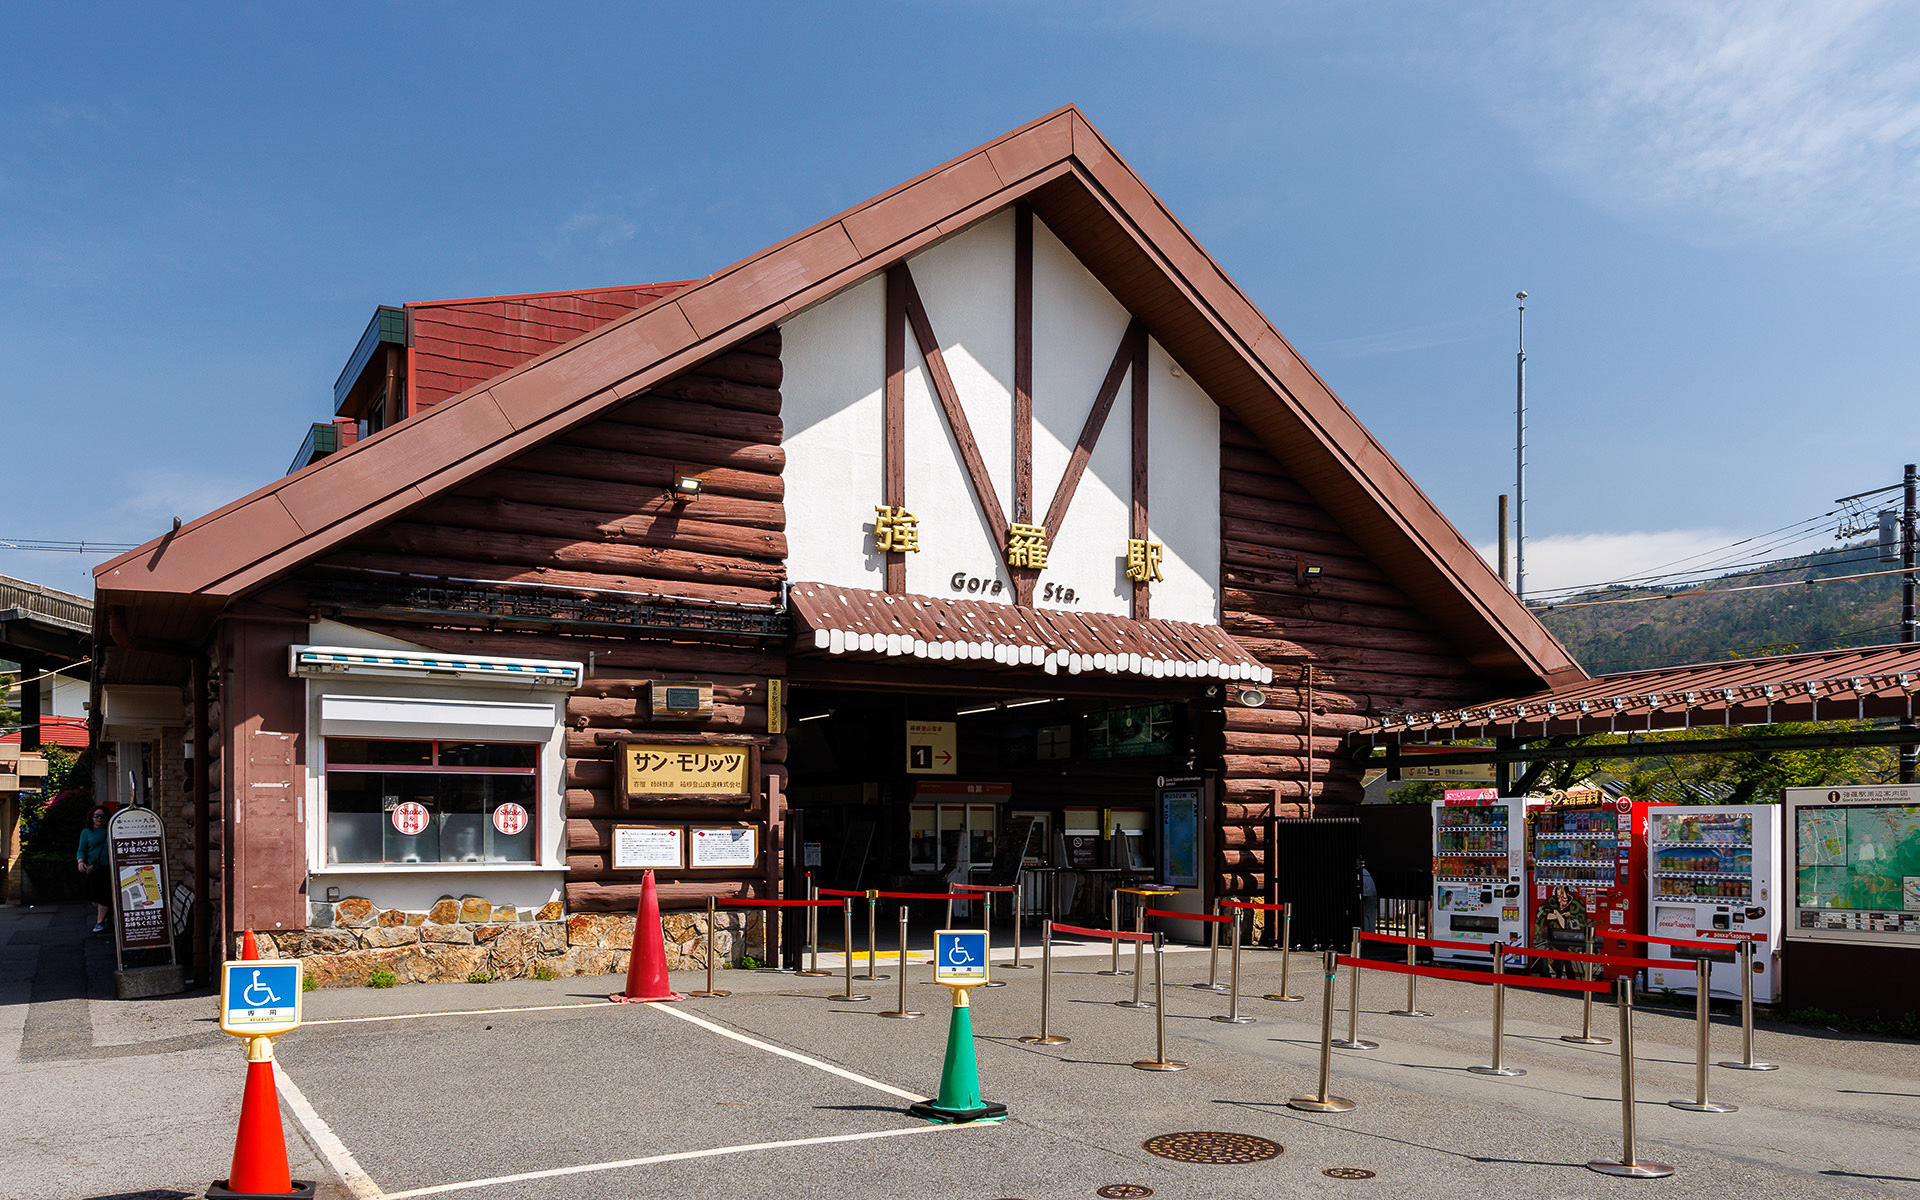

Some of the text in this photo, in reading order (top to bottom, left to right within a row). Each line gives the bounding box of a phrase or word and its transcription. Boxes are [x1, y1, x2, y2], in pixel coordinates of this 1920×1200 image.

[951, 572, 1003, 595] Gora
[634, 753, 741, 772] サン・モリッツ
[916, 749, 924, 765] 1
[117, 846, 160, 854] 乗り場のご案内
